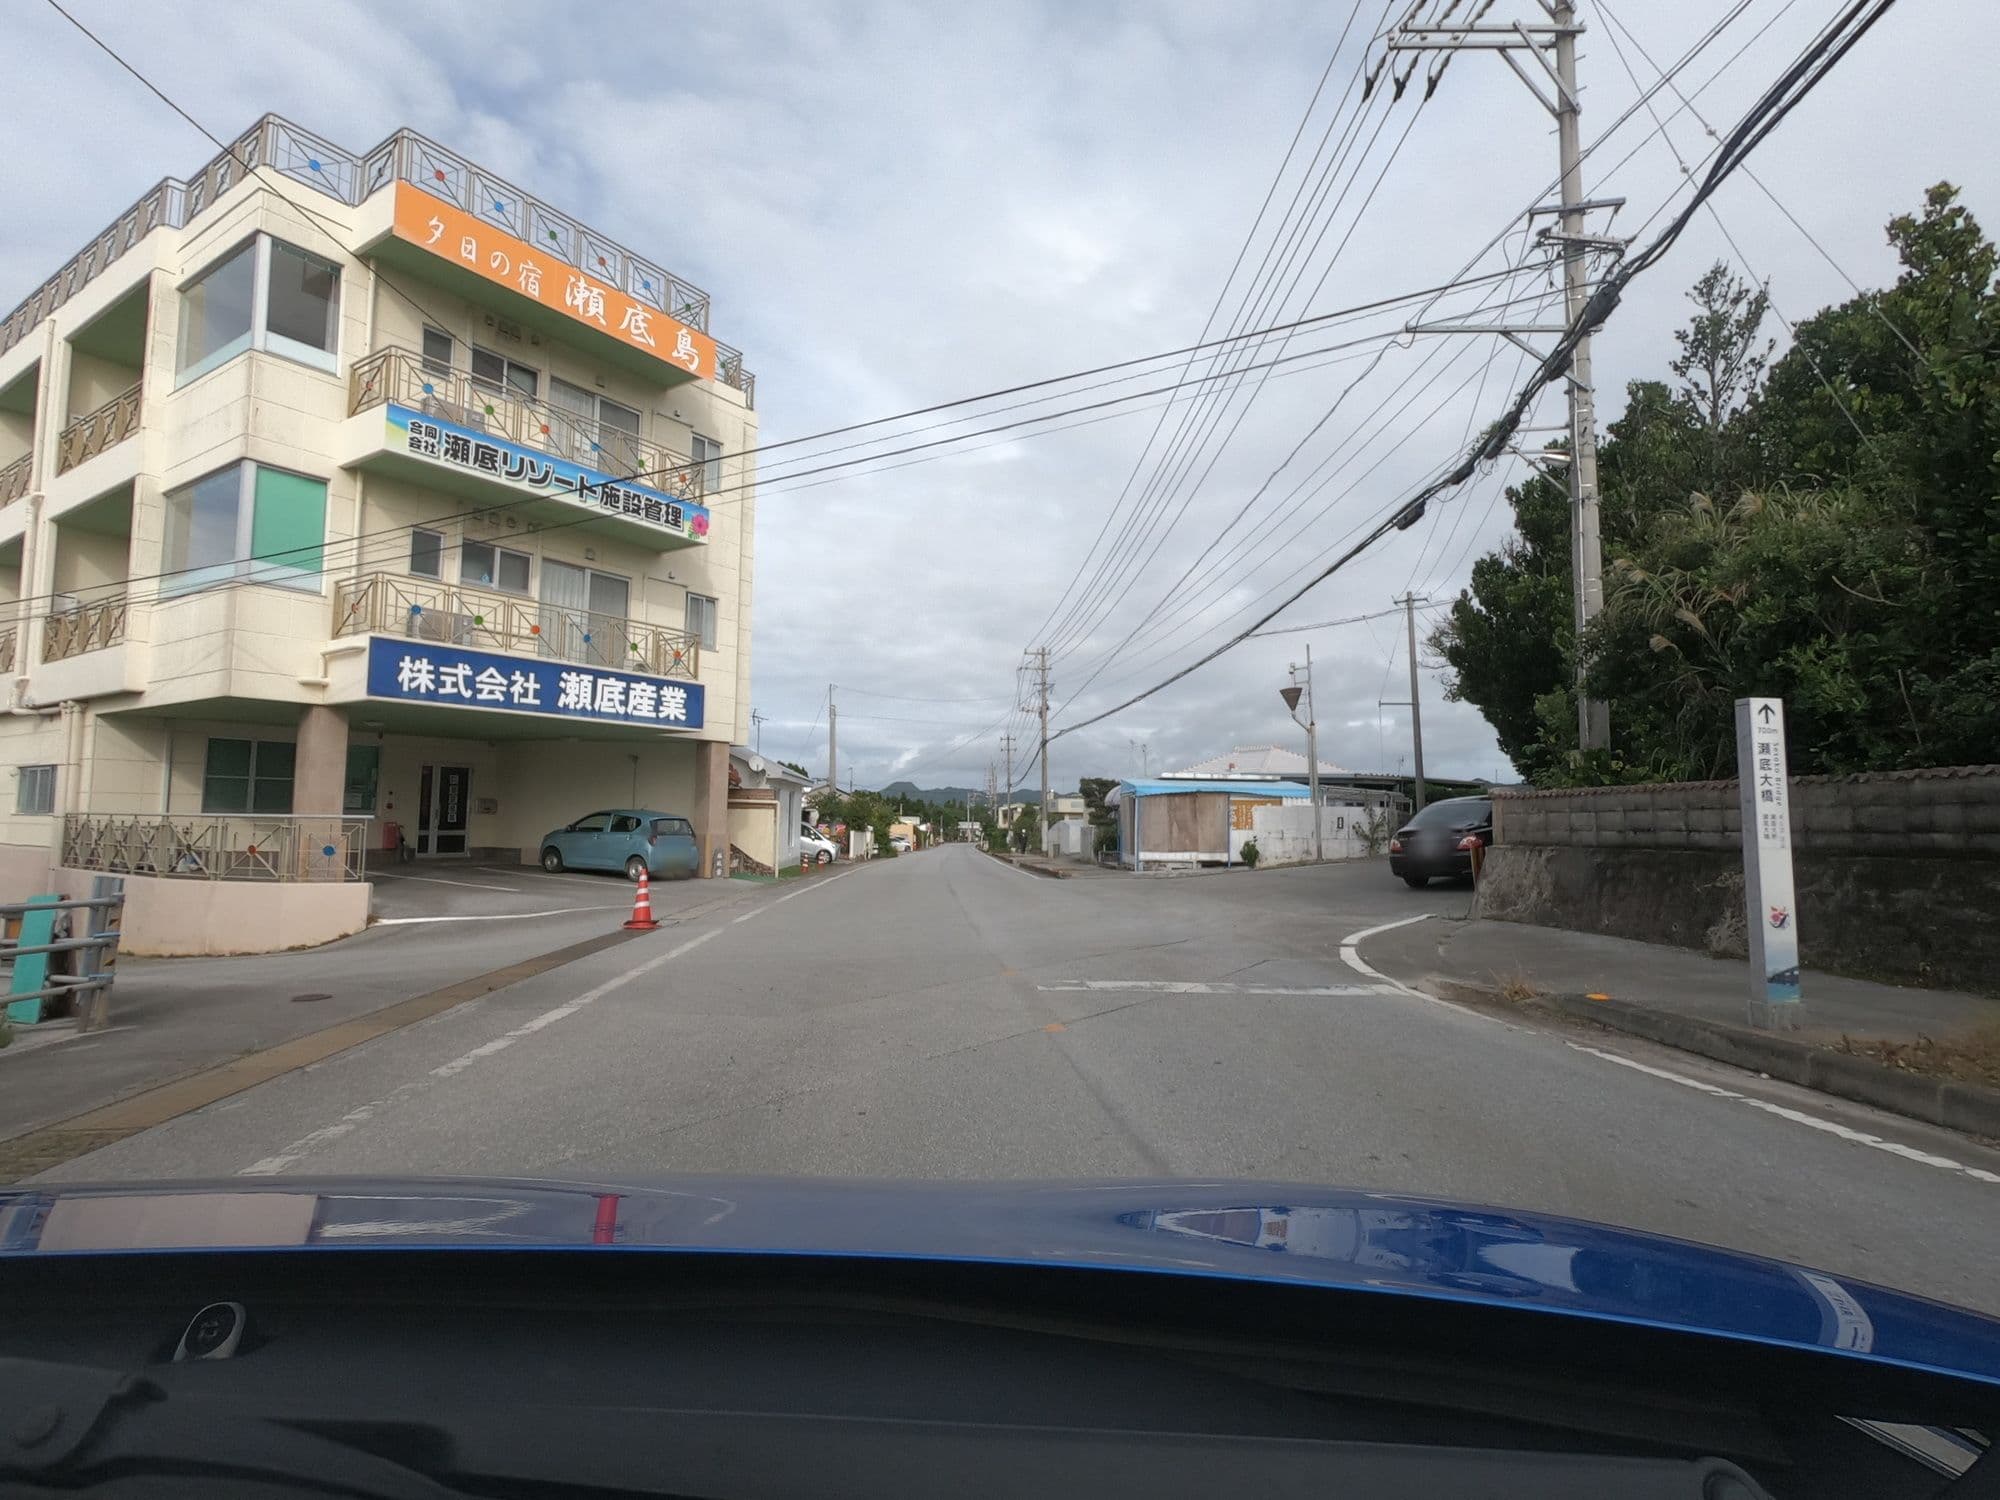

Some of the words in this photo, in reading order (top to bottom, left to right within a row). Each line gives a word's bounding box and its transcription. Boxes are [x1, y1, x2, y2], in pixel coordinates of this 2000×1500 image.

[425, 215, 543, 298] 夕日の宿
[565, 274, 700, 371] 瀬底島
[409, 421, 438, 439] 合同
[409, 436, 438, 455] 会社
[443, 431, 682, 529] 瀬底リゾート施設管理
[397, 656, 541, 705] 株式会社
[557, 671, 688, 721] 瀬底産業
[1757, 742, 1774, 803] 瀬底大橋
